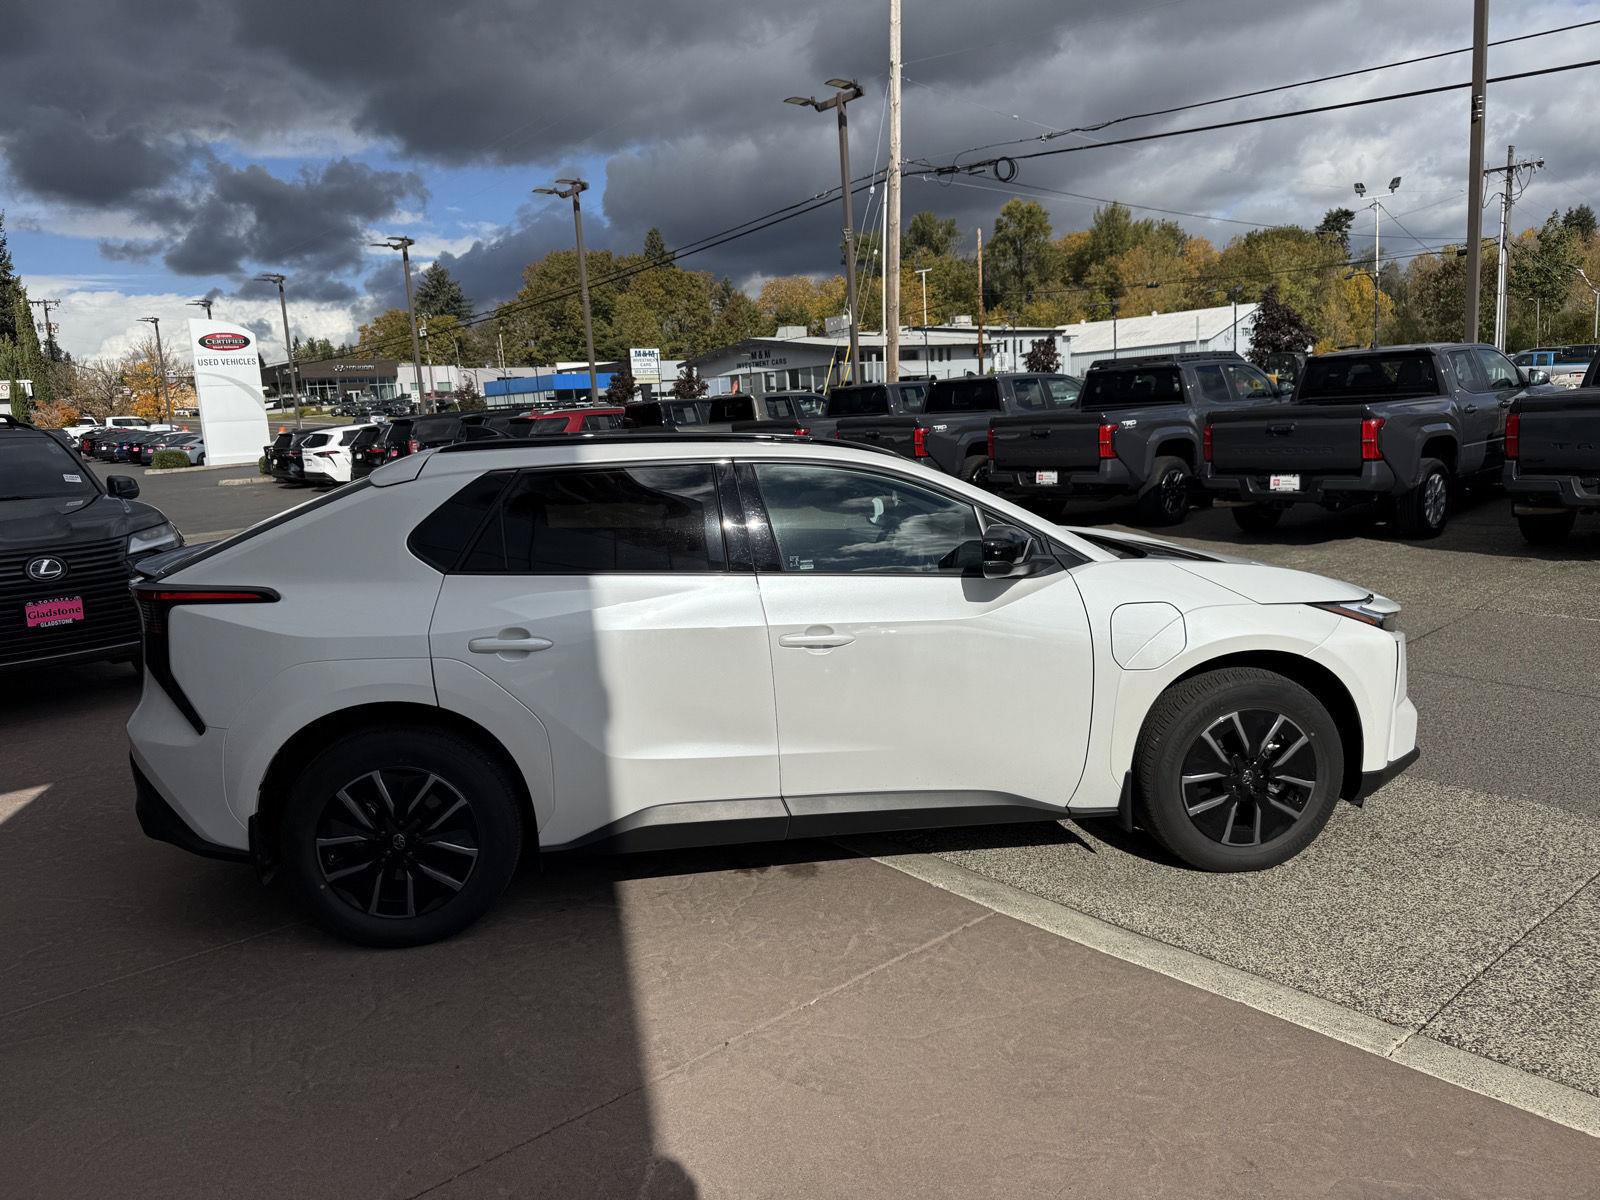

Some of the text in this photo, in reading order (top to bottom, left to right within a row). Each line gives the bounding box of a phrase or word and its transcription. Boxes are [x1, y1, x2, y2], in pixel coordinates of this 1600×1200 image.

[197, 357, 257, 367] USED VEHICLES
[736, 358, 787, 369] INVESTMENT CARS
[38, 596, 69, 605] TOYOTA
[27, 606, 82, 620] Gladstone
[39, 618, 73, 628] GLADSTONE
